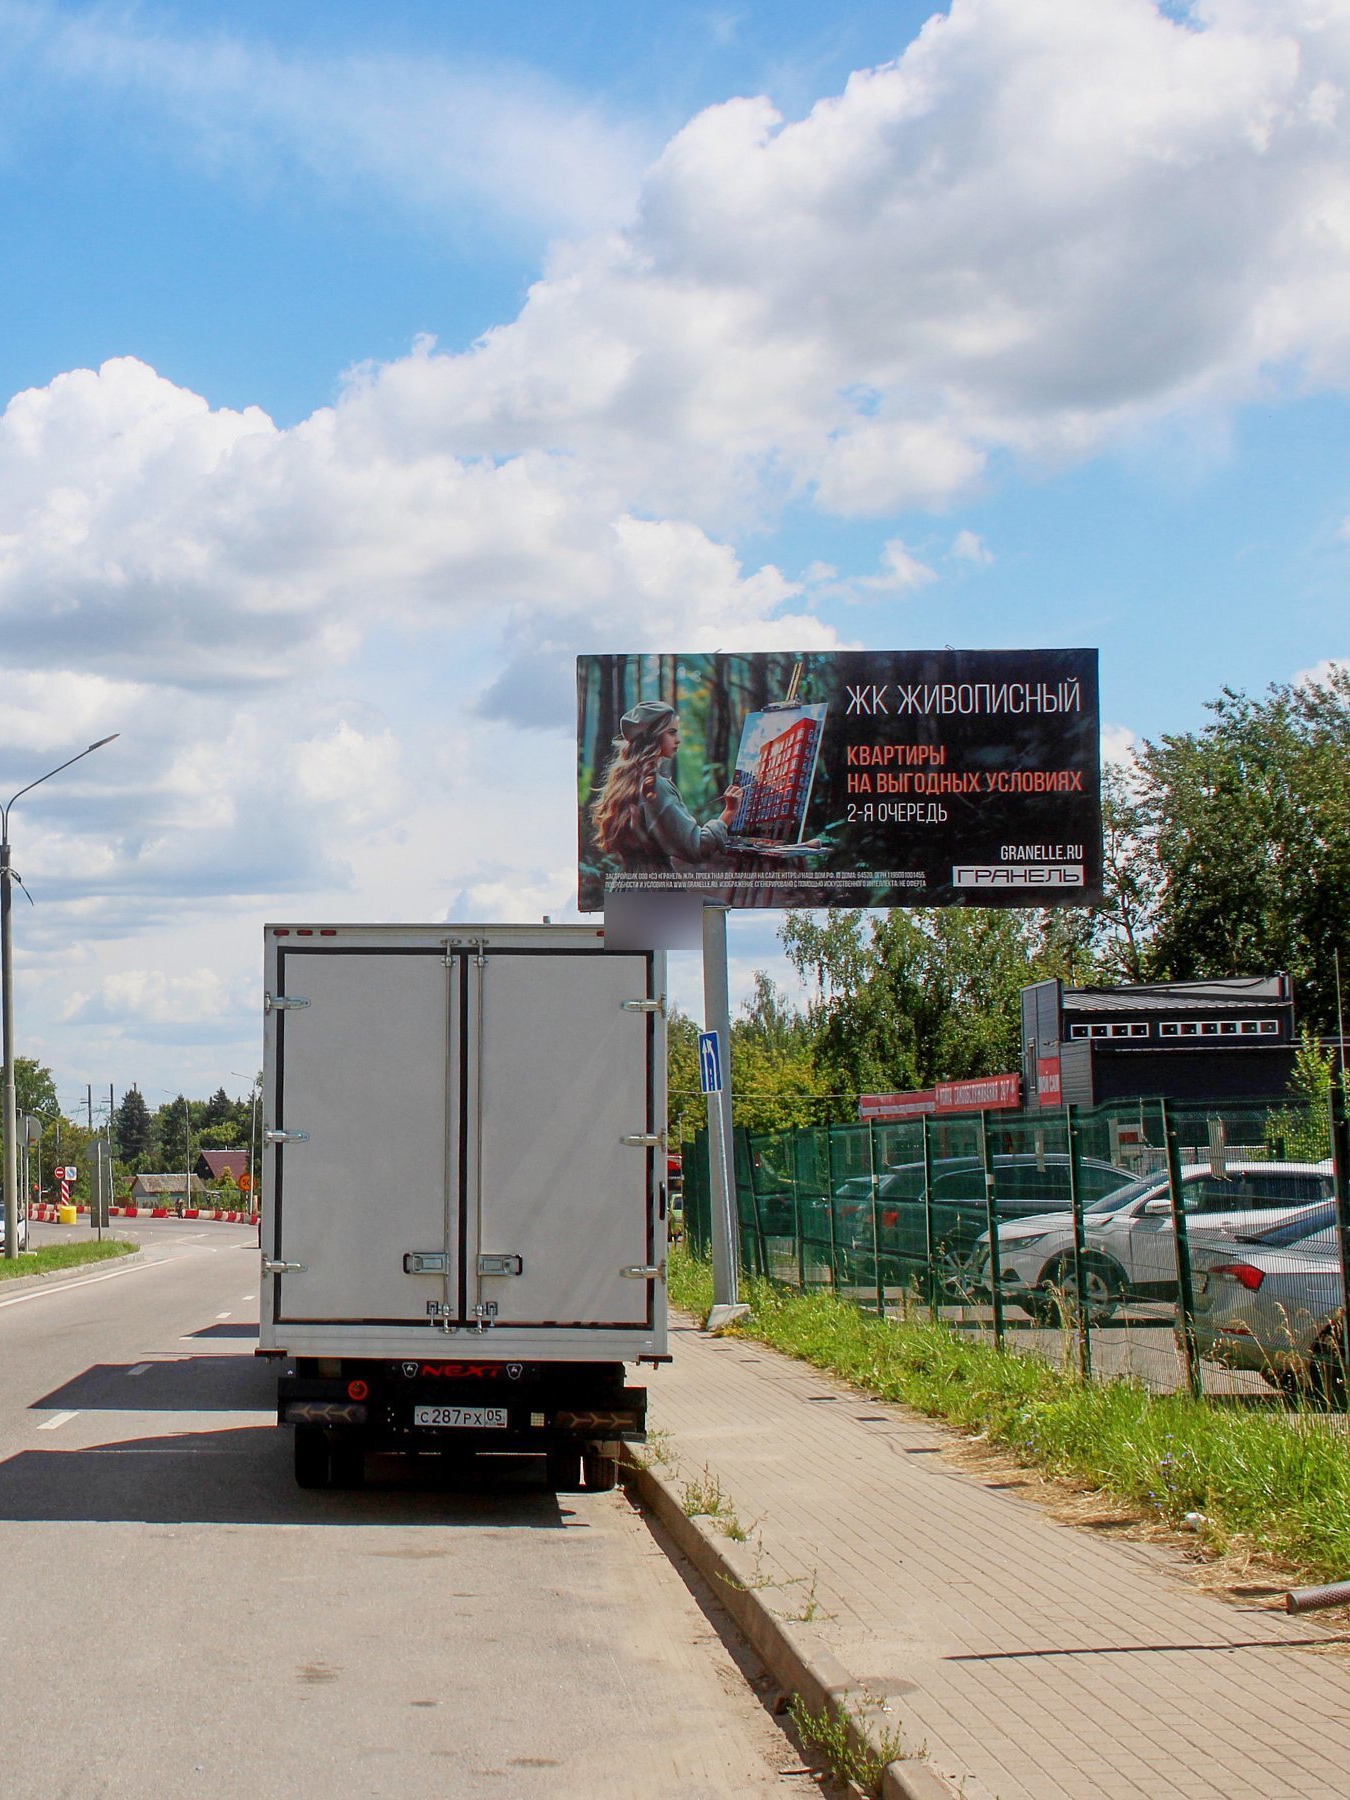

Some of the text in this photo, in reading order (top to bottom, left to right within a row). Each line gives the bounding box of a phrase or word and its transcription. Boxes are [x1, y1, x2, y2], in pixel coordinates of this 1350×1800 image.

[846, 677, 1080, 715] ЖК ЖИВОПИСНЫЙ
[847, 745, 945, 766] КВАРТИРЫ
[847, 771, 1083, 795] НА ВЫГОДНЫХ УСЛОВИЯХ
[847, 803, 948, 824] 2-Я ОЧЕРЕДЬ
[1000, 845, 1083, 860] GRANELLE.RU
[957, 869, 1080, 883] ГРАНЕЛЬ
[422, 1365, 503, 1377] NEXT
